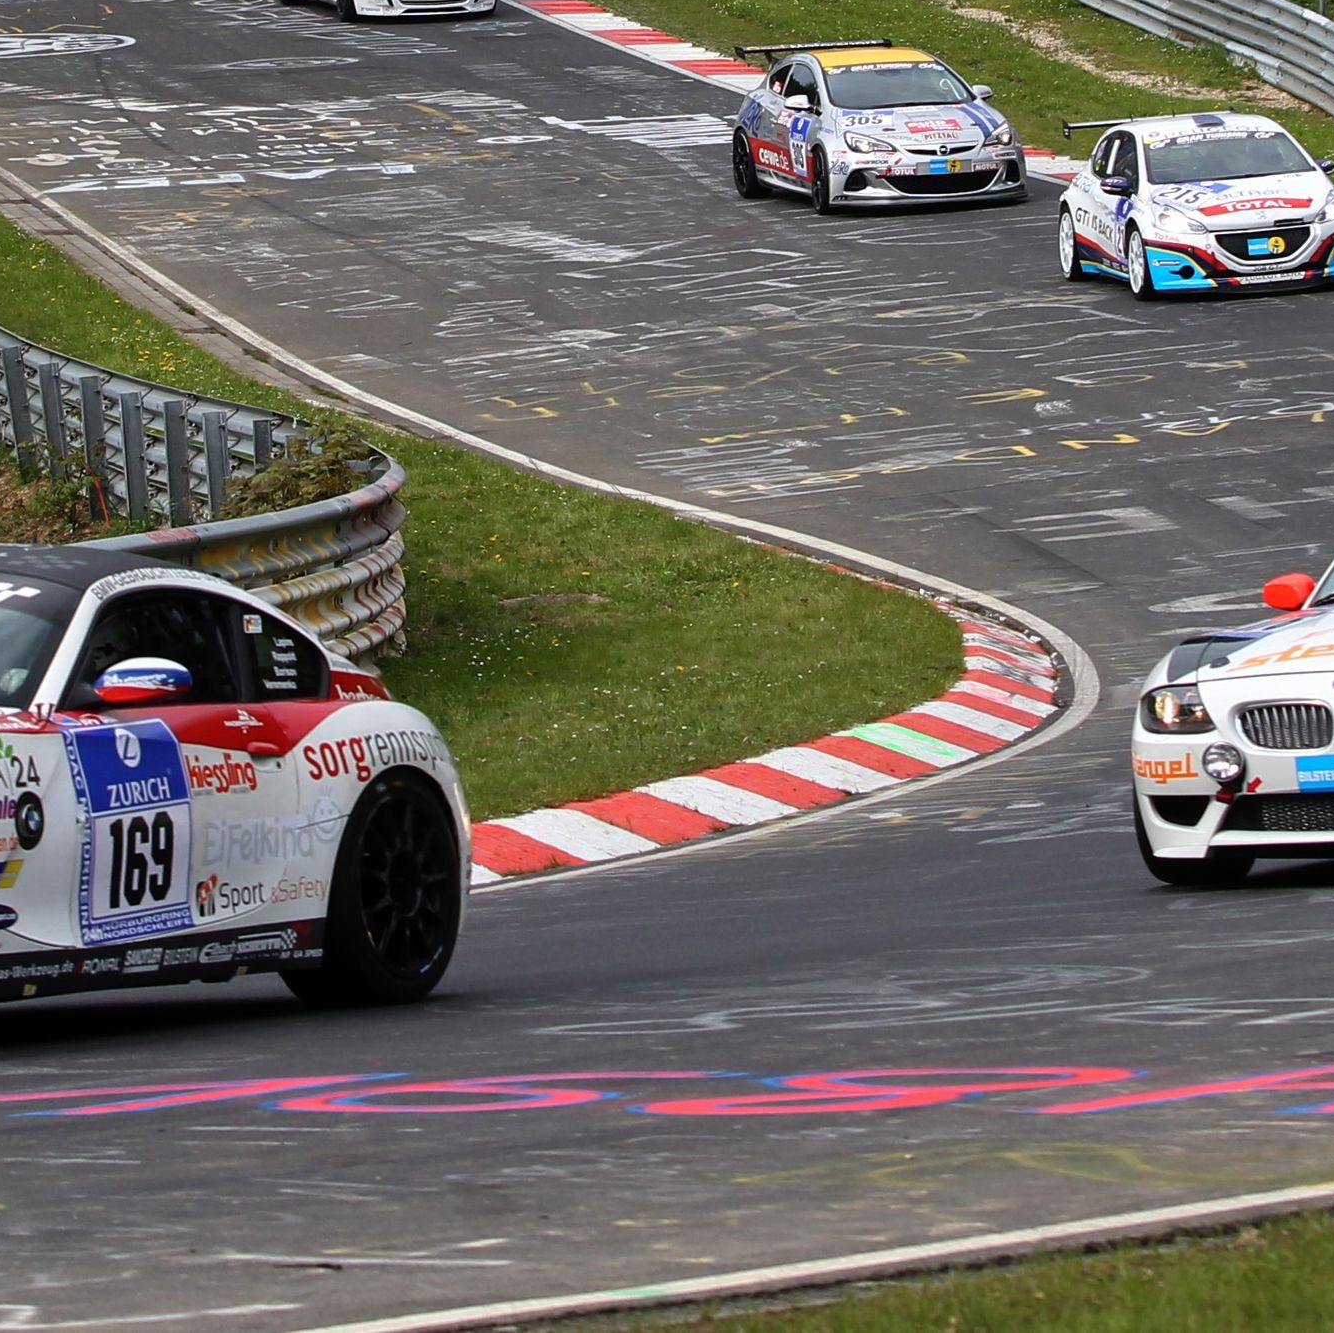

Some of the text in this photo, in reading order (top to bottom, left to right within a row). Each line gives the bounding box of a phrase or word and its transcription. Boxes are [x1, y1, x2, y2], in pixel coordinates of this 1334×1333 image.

[844, 114, 884, 127] 305
[1176, 134, 1204, 144] GRAN
[1205, 132, 1248, 140] TURISMO
[889, 167, 916, 176] OTUL
[1158, 186, 1208, 205] 215
[1220, 199, 1293, 213] TOTAL
[10, 754, 42, 788] 24
[185, 752, 258, 794] kiessling
[107, 776, 172, 808] ZURICH
[202, 812, 315, 867] EiFelkind
[109, 810, 174, 909] 169
[219, 881, 267, 914] Sport
[103, 917, 193, 940] NORDSCHLEIFE
